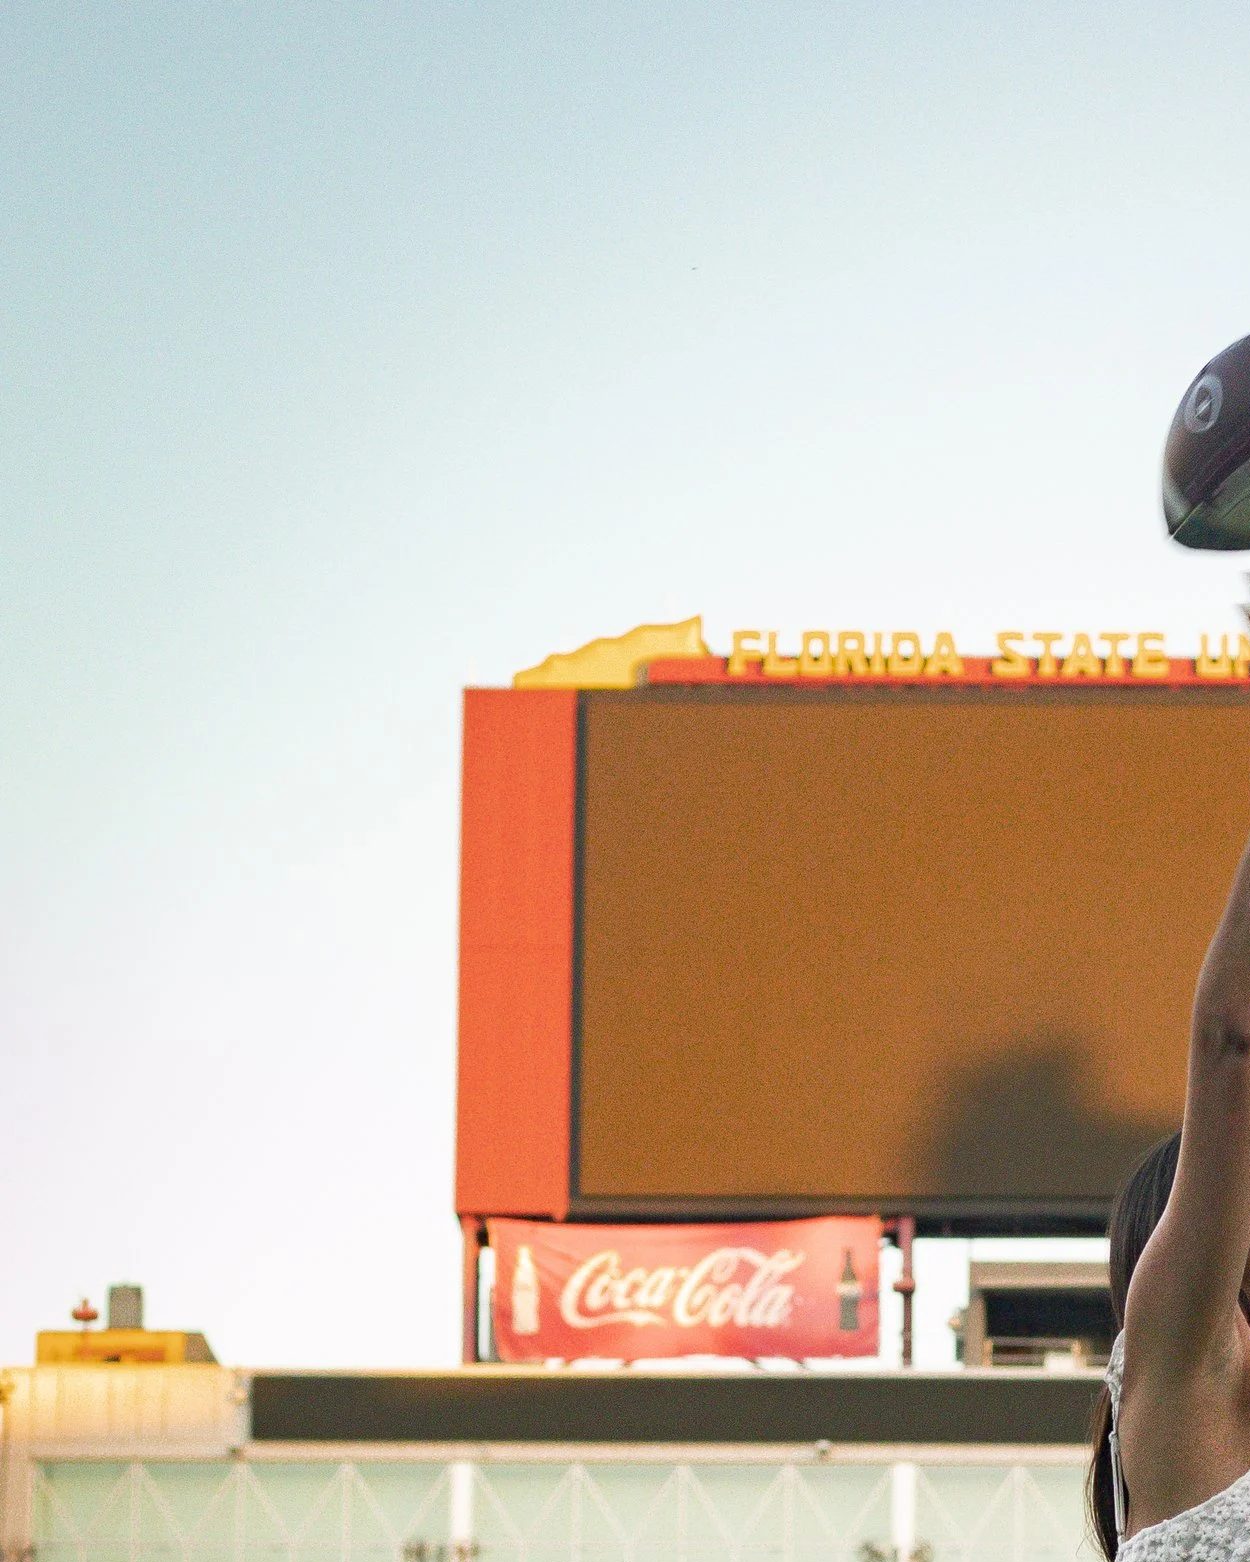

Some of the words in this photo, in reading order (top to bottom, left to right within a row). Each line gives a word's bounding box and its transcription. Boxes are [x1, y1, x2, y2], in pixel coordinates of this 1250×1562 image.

[727, 631, 965, 677] FLORIDA
[991, 632, 1170, 678] STATE
[560, 1247, 805, 1329] Coca-Cola
